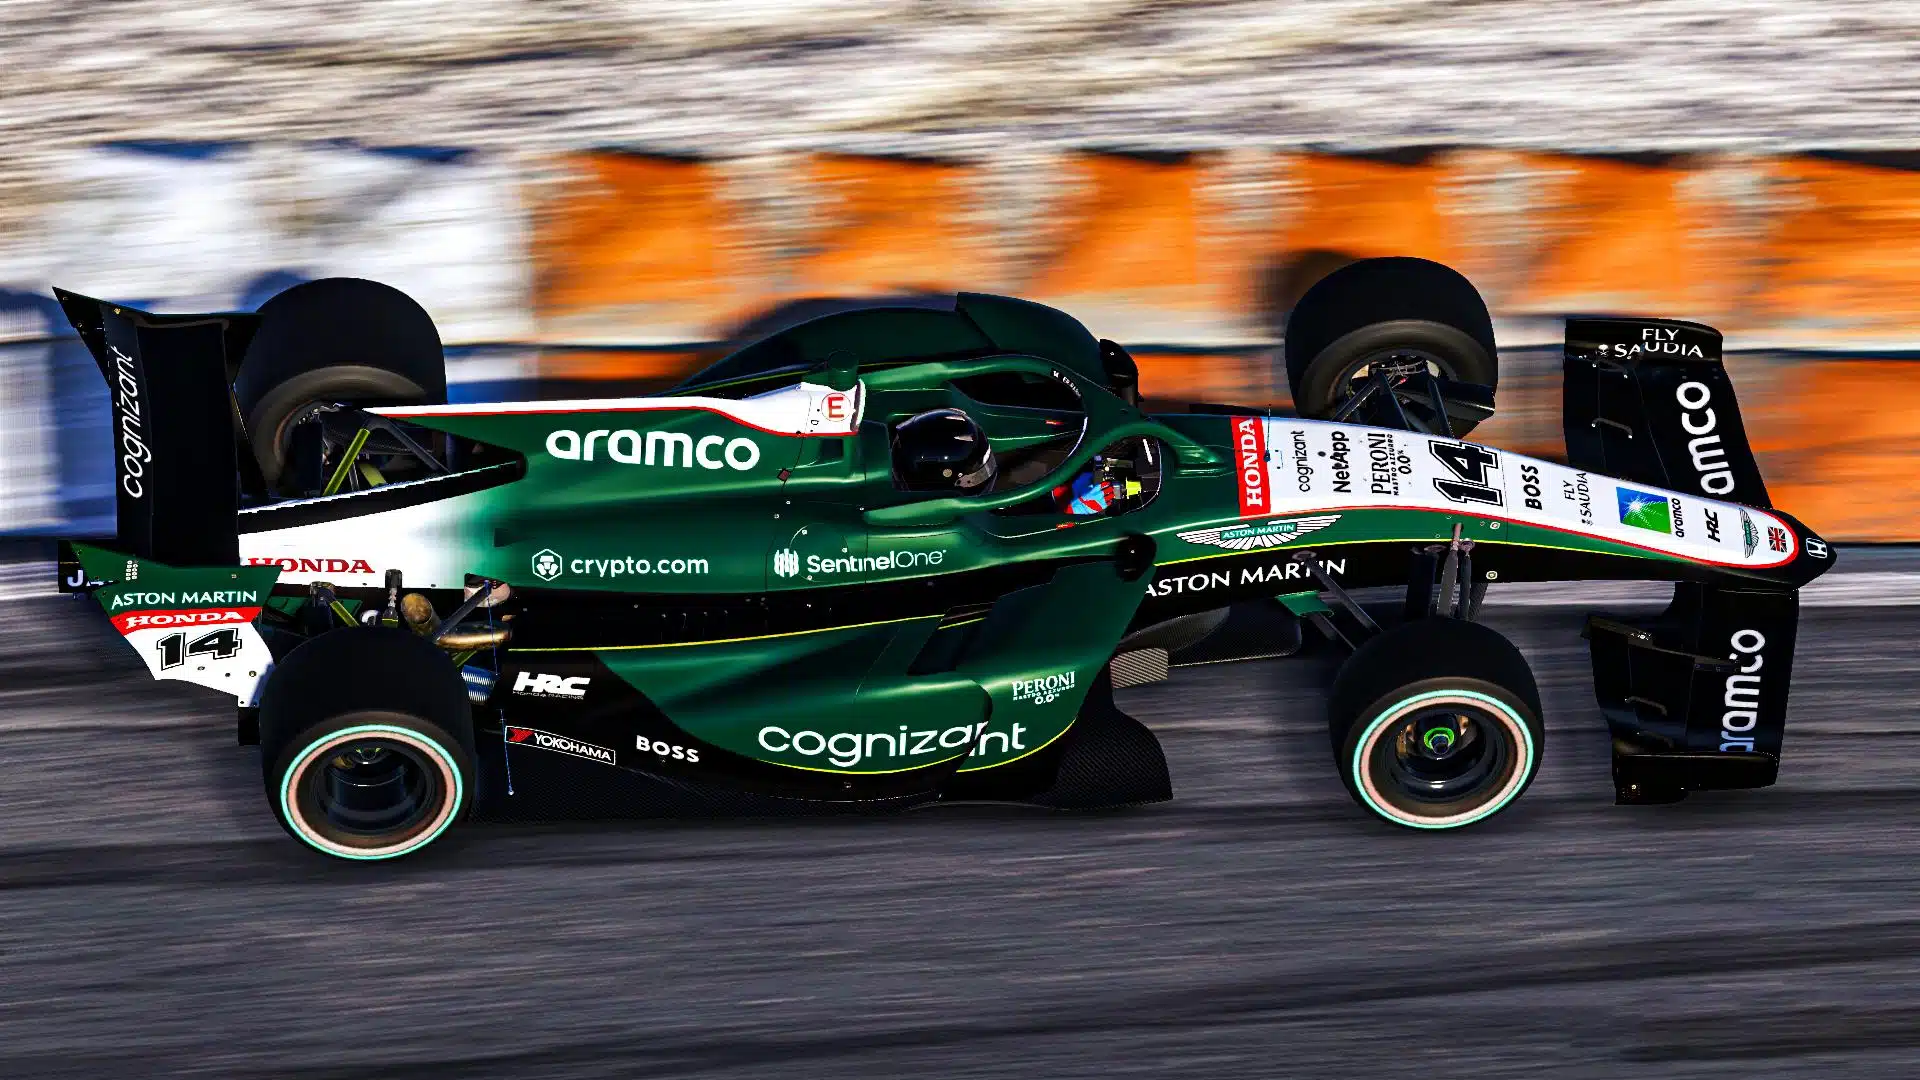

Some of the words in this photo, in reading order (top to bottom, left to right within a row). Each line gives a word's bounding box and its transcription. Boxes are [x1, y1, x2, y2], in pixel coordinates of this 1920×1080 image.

[1614, 341, 1704, 358] SAUDIA
[1642, 328, 1680, 341] FLY
[110, 346, 152, 499] cognizant
[1676, 380, 1735, 496] amco
[545, 429, 761, 471] aramco
[1238, 419, 1263, 508] HONDA
[1291, 430, 1314, 493] cognizant
[1330, 430, 1352, 494] NetApp
[1367, 432, 1392, 496] PERONI
[1427, 439, 1504, 508] 14
[1520, 463, 1543, 511] BOSS
[1562, 479, 1576, 501] FLY
[1575, 472, 1593, 519] SAUDIA
[1222, 528, 1255, 539] ASTON
[1256, 524, 1295, 535] MARTIN
[1670, 497, 1686, 539] aramco
[570, 556, 709, 578] crypto.com
[806, 549, 943, 574] SentinelOne
[1145, 570, 1231, 598] ASTON
[1239, 558, 1346, 585] MARTN
[111, 592, 176, 610] ASTON
[181, 590, 257, 604] MARTIN
[125, 611, 246, 630] HONDA
[156, 627, 243, 671] 14
[512, 671, 591, 695] HRC
[1011, 671, 1076, 697] PERONI
[534, 732, 611, 761] YOKOHAMA
[635, 735, 700, 763] BOSS
[758, 723, 1027, 767] cognizant
